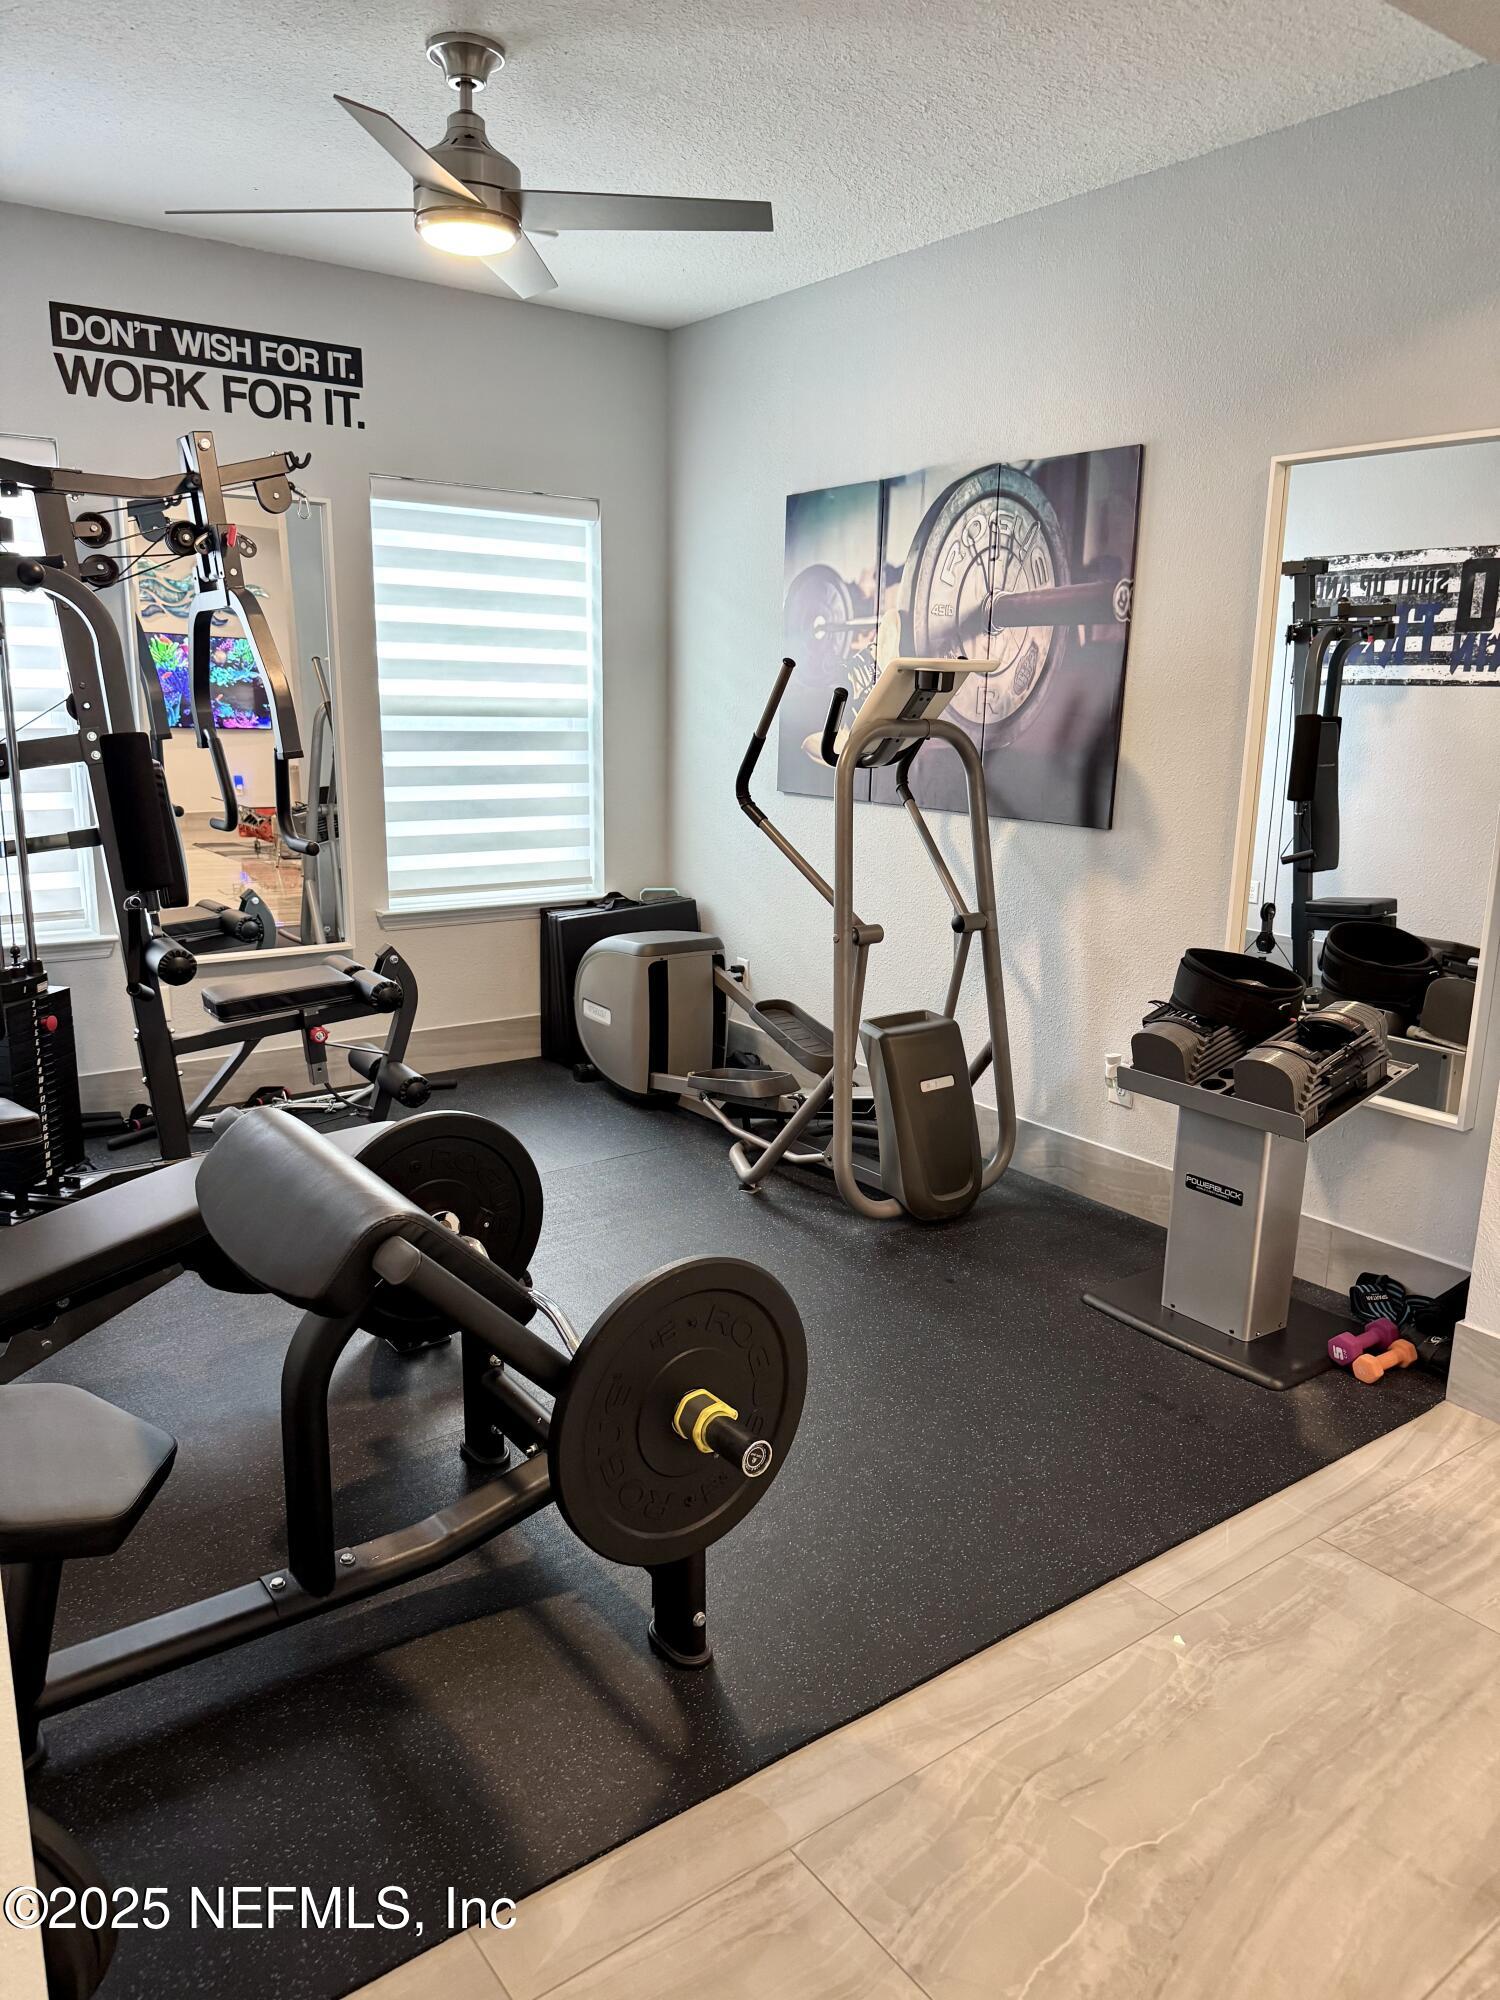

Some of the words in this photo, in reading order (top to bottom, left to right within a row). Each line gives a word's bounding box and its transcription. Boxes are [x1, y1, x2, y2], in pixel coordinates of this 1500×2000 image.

[59, 311, 162, 352] DON'T
[171, 328, 252, 365] WISH
[260, 341, 319, 375] FOR
[326, 351, 356, 380] IT.
[53, 352, 210, 411] WORK
[222, 375, 312, 423] FOR
[325, 388, 365, 429] IT.
[32, 1000, 36, 1008] 2
[33, 1009, 37, 1017] 3
[34, 1019, 38, 1027] 4
[34, 1029, 39, 1037] 5
[36, 1048, 40, 1056] 7
[1186, 1175, 1242, 1201] POWERBLOCK
